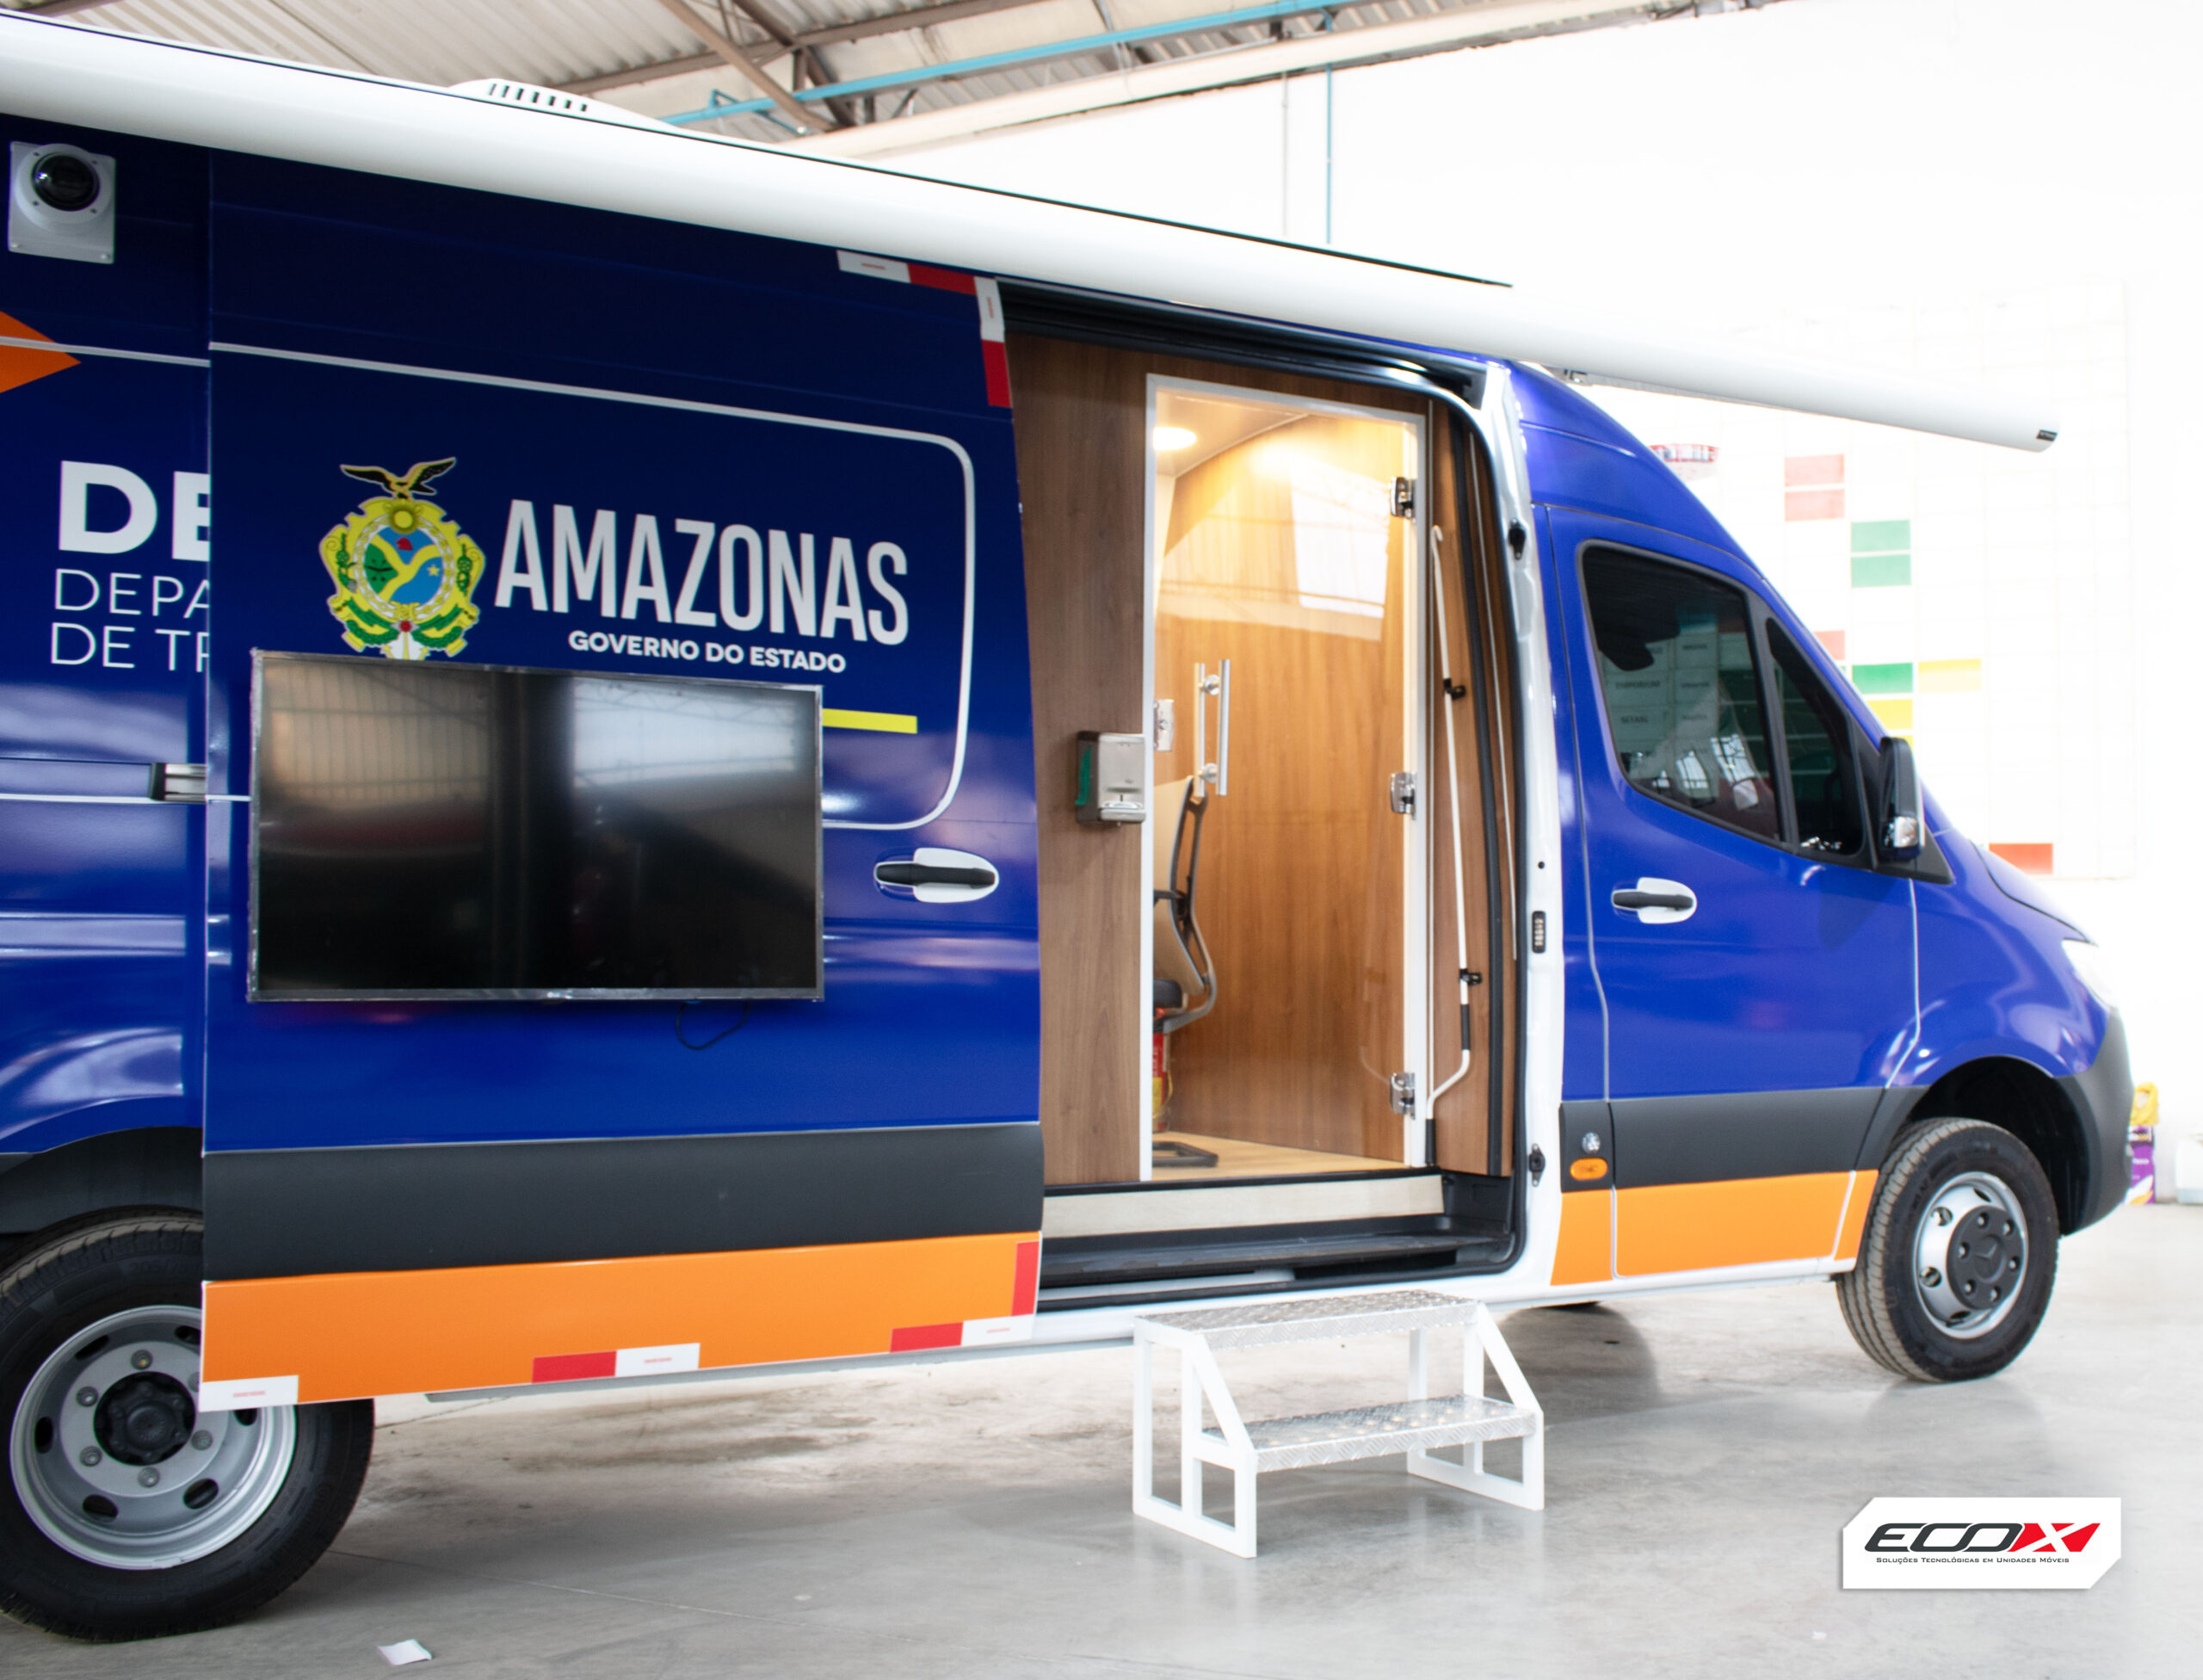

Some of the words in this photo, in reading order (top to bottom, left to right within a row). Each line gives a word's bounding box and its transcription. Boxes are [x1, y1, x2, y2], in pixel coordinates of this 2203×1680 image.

[495, 499, 909, 645] AMAZONAS
[51, 622, 135, 669] DE
[568, 630, 699, 660] GOVERNO
[705, 642, 744, 664] DO
[750, 646, 846, 673] ESTADO
